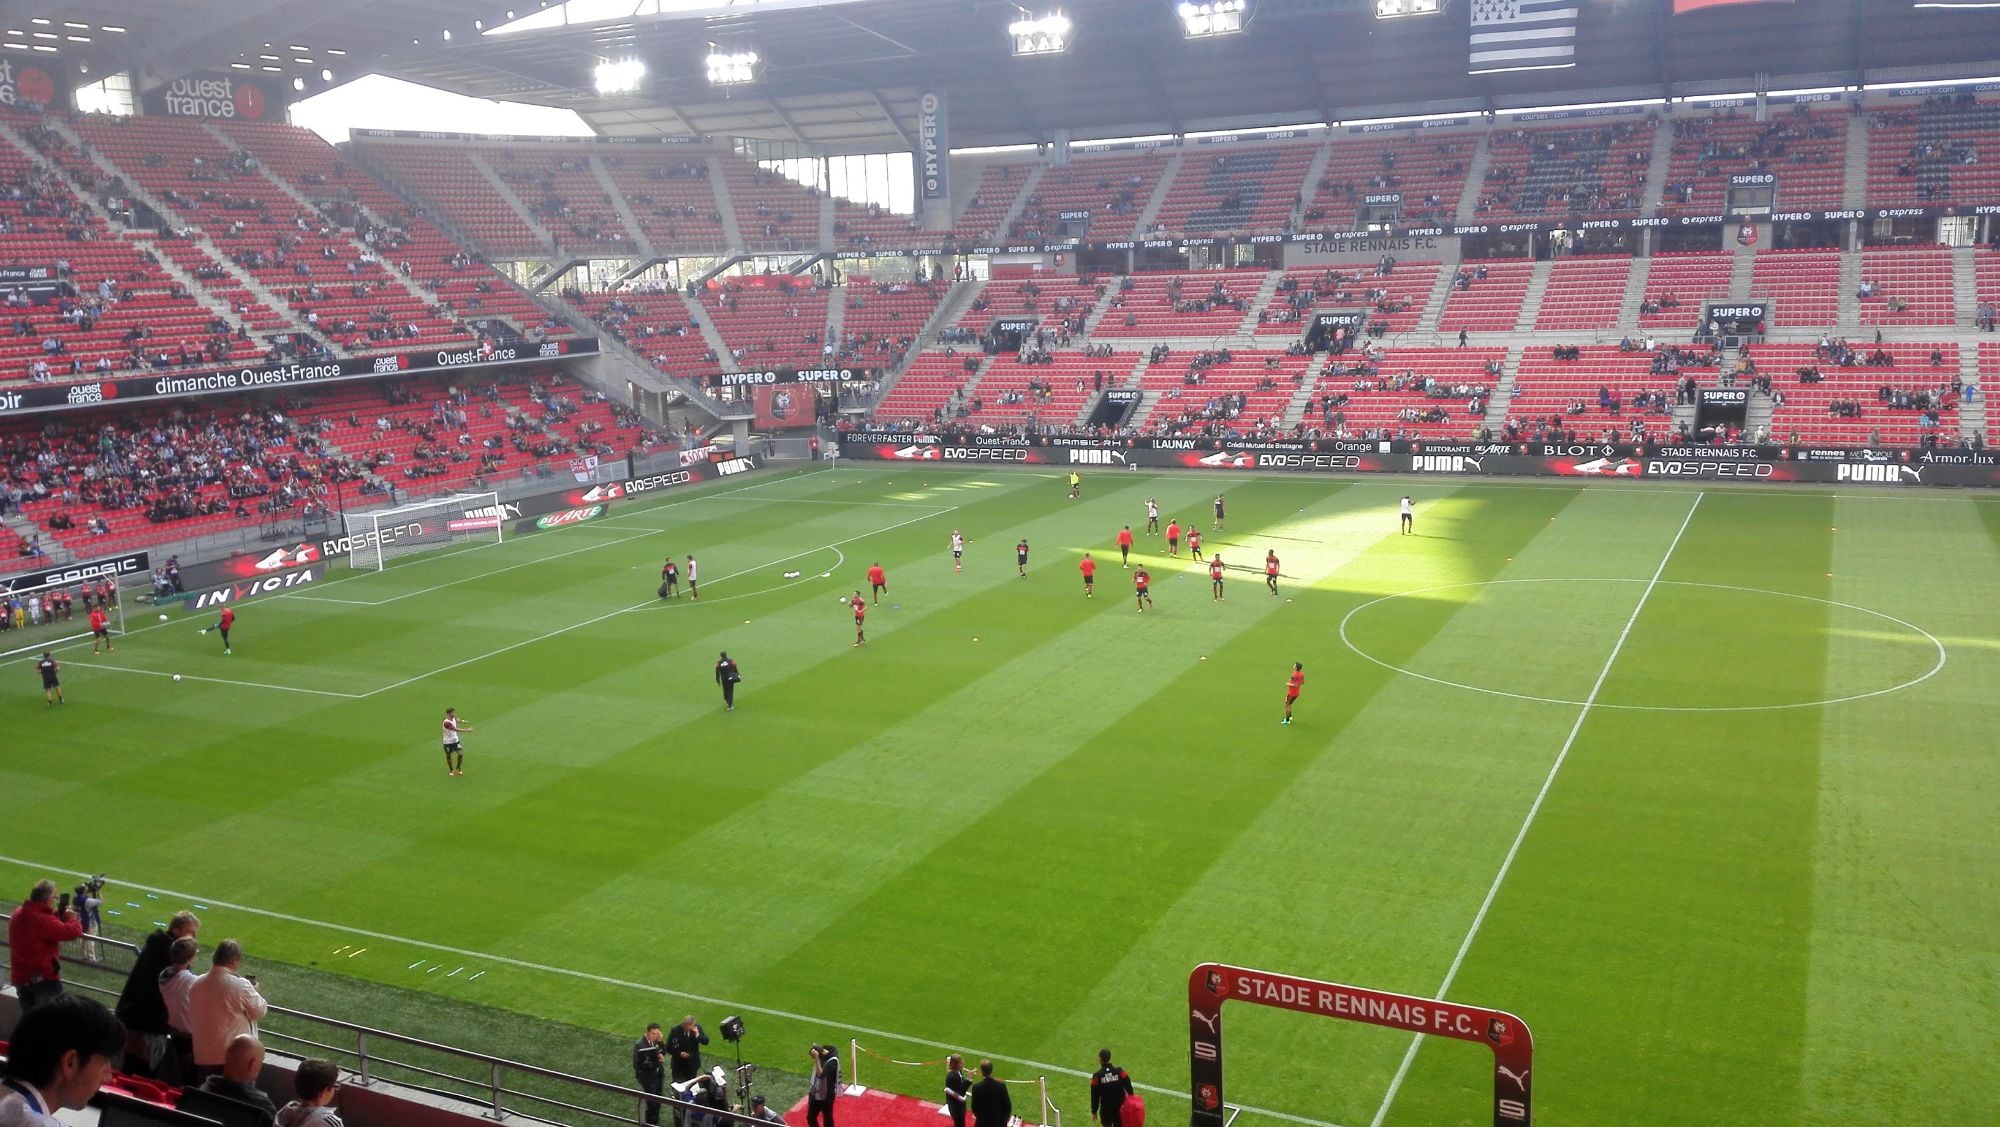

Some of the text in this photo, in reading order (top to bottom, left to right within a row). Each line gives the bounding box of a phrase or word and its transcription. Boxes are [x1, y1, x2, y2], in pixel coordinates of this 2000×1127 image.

[172, 78, 232, 98] ouest
[165, 91, 235, 117] france
[1710, 100, 1735, 108] SUPER
[1796, 95, 1822, 103] SUPER
[1732, 175, 1764, 184] SUPER
[1060, 211, 1082, 219] SUPER
[1409, 228, 1434, 236] HYPER
[1454, 226, 1480, 234] SUPER
[1304, 239, 1437, 254] STADE RENNAIS F.C.
[1713, 308, 1750, 317] SUPER
[375, 356, 398, 366] ouest
[374, 362, 399, 373] france
[155, 362, 341, 394] dimanche Ouest-France
[722, 373, 762, 385] HYPER
[798, 370, 838, 381] SUPER
[71, 382, 102, 395] ouest
[67, 392, 102, 404] france
[1704, 392, 1735, 400] SUPER
[976, 437, 1030, 447] Ouest-France
[1226, 441, 1244, 449] Crédit
[1277, 443, 1303, 451] Bretagne
[1336, 442, 1372, 453] Orange
[944, 448, 1027, 460] EVOSPEED
[1544, 446, 1598, 456] BLOT
[1661, 448, 1758, 458] STADE RENNAIS F.C.
[1260, 455, 1360, 467] EVOSPEED
[1648, 462, 1772, 476] EVOSPEED
[626, 471, 690, 493] EVOSPEED
[196, 571, 312, 609] INVICTA
[1237, 977, 1479, 1036] STADE RENNAIS F.C.
